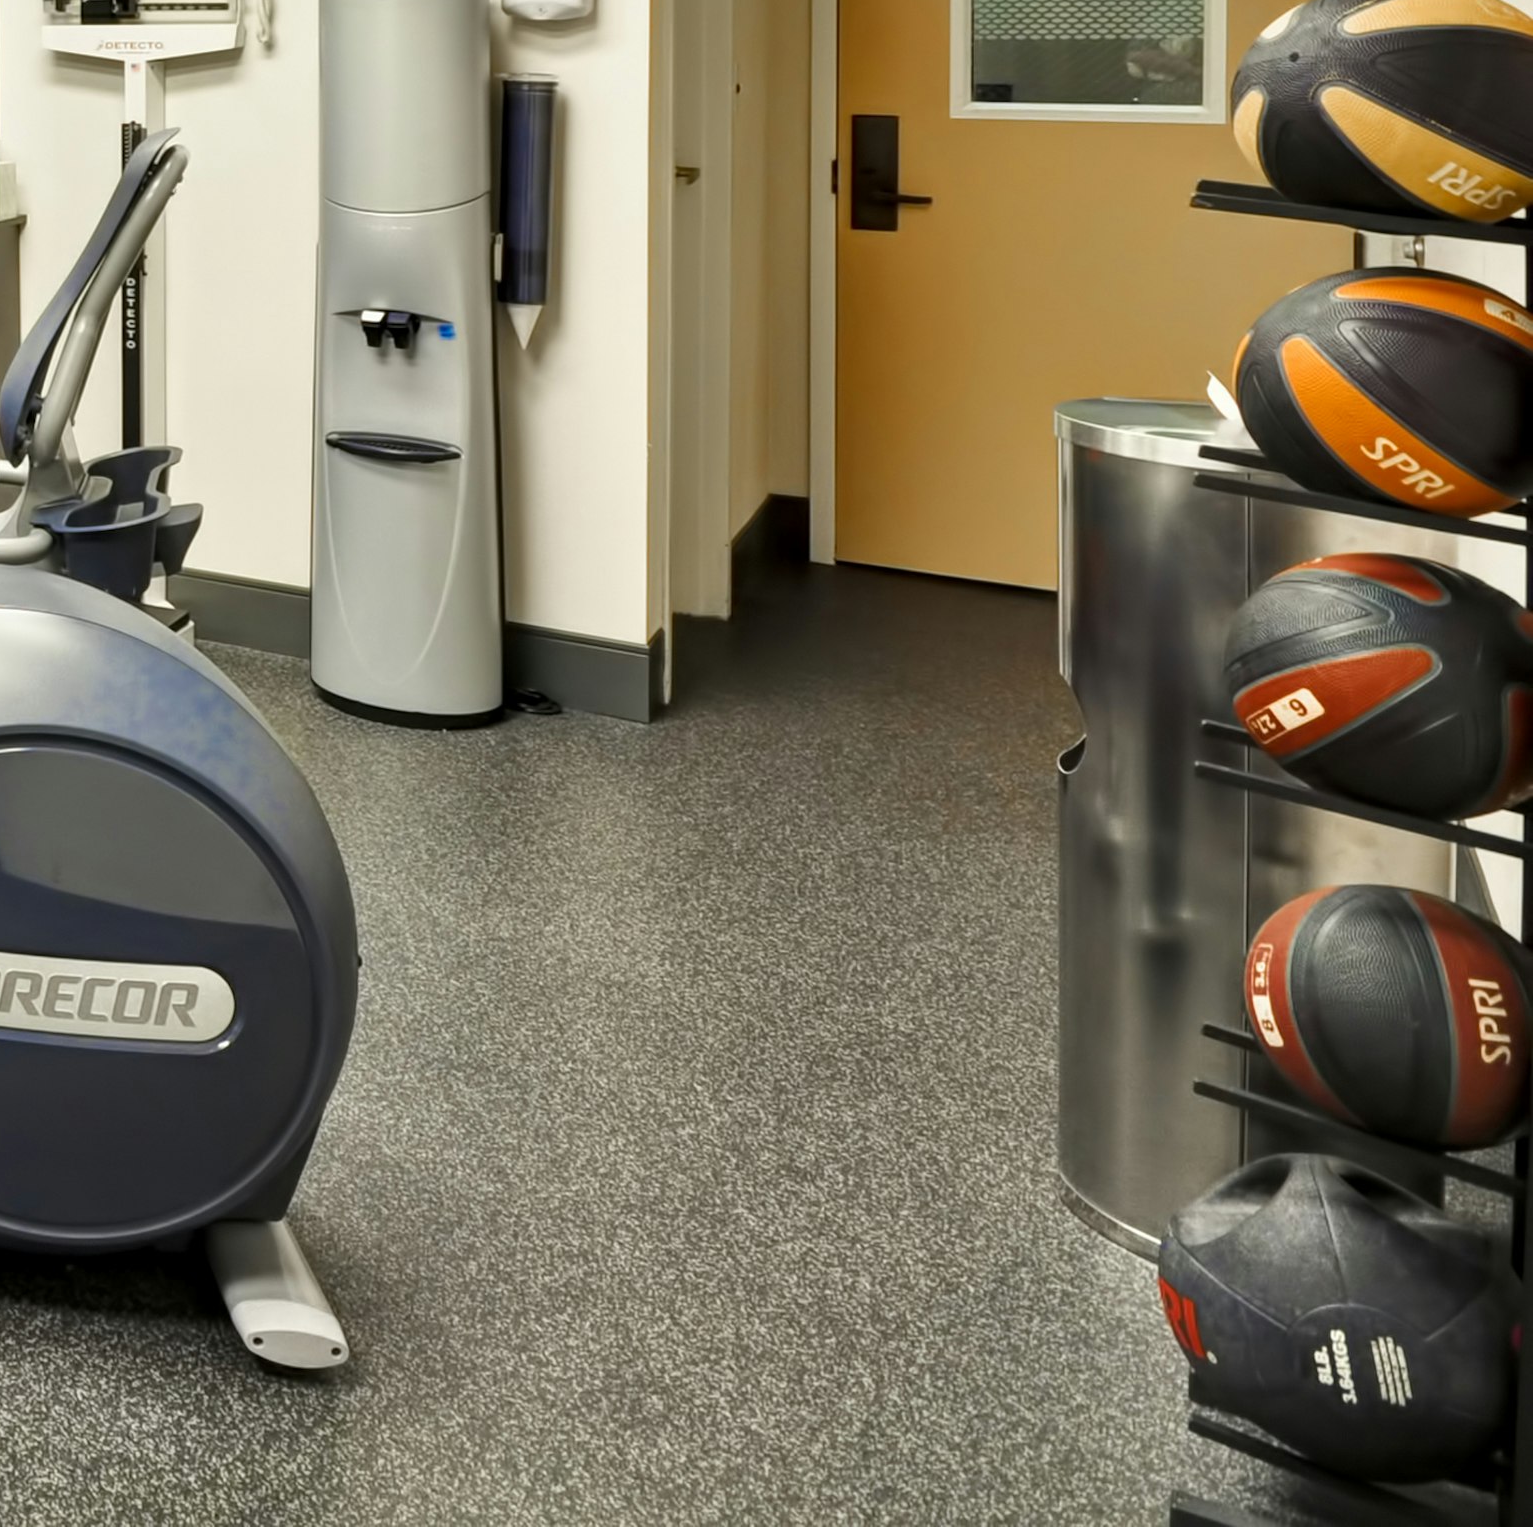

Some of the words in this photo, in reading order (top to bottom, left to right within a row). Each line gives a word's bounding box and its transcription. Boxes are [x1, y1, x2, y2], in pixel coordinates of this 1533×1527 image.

[105, 41, 164, 50] DETECTO
[1426, 161, 1517, 210] SPRI
[125, 277, 136, 350] DETECTO
[1360, 436, 1456, 500] SPRI
[1467, 978, 1512, 1065] SPRI
[1329, 1329, 1358, 1405] 3.64KGS
